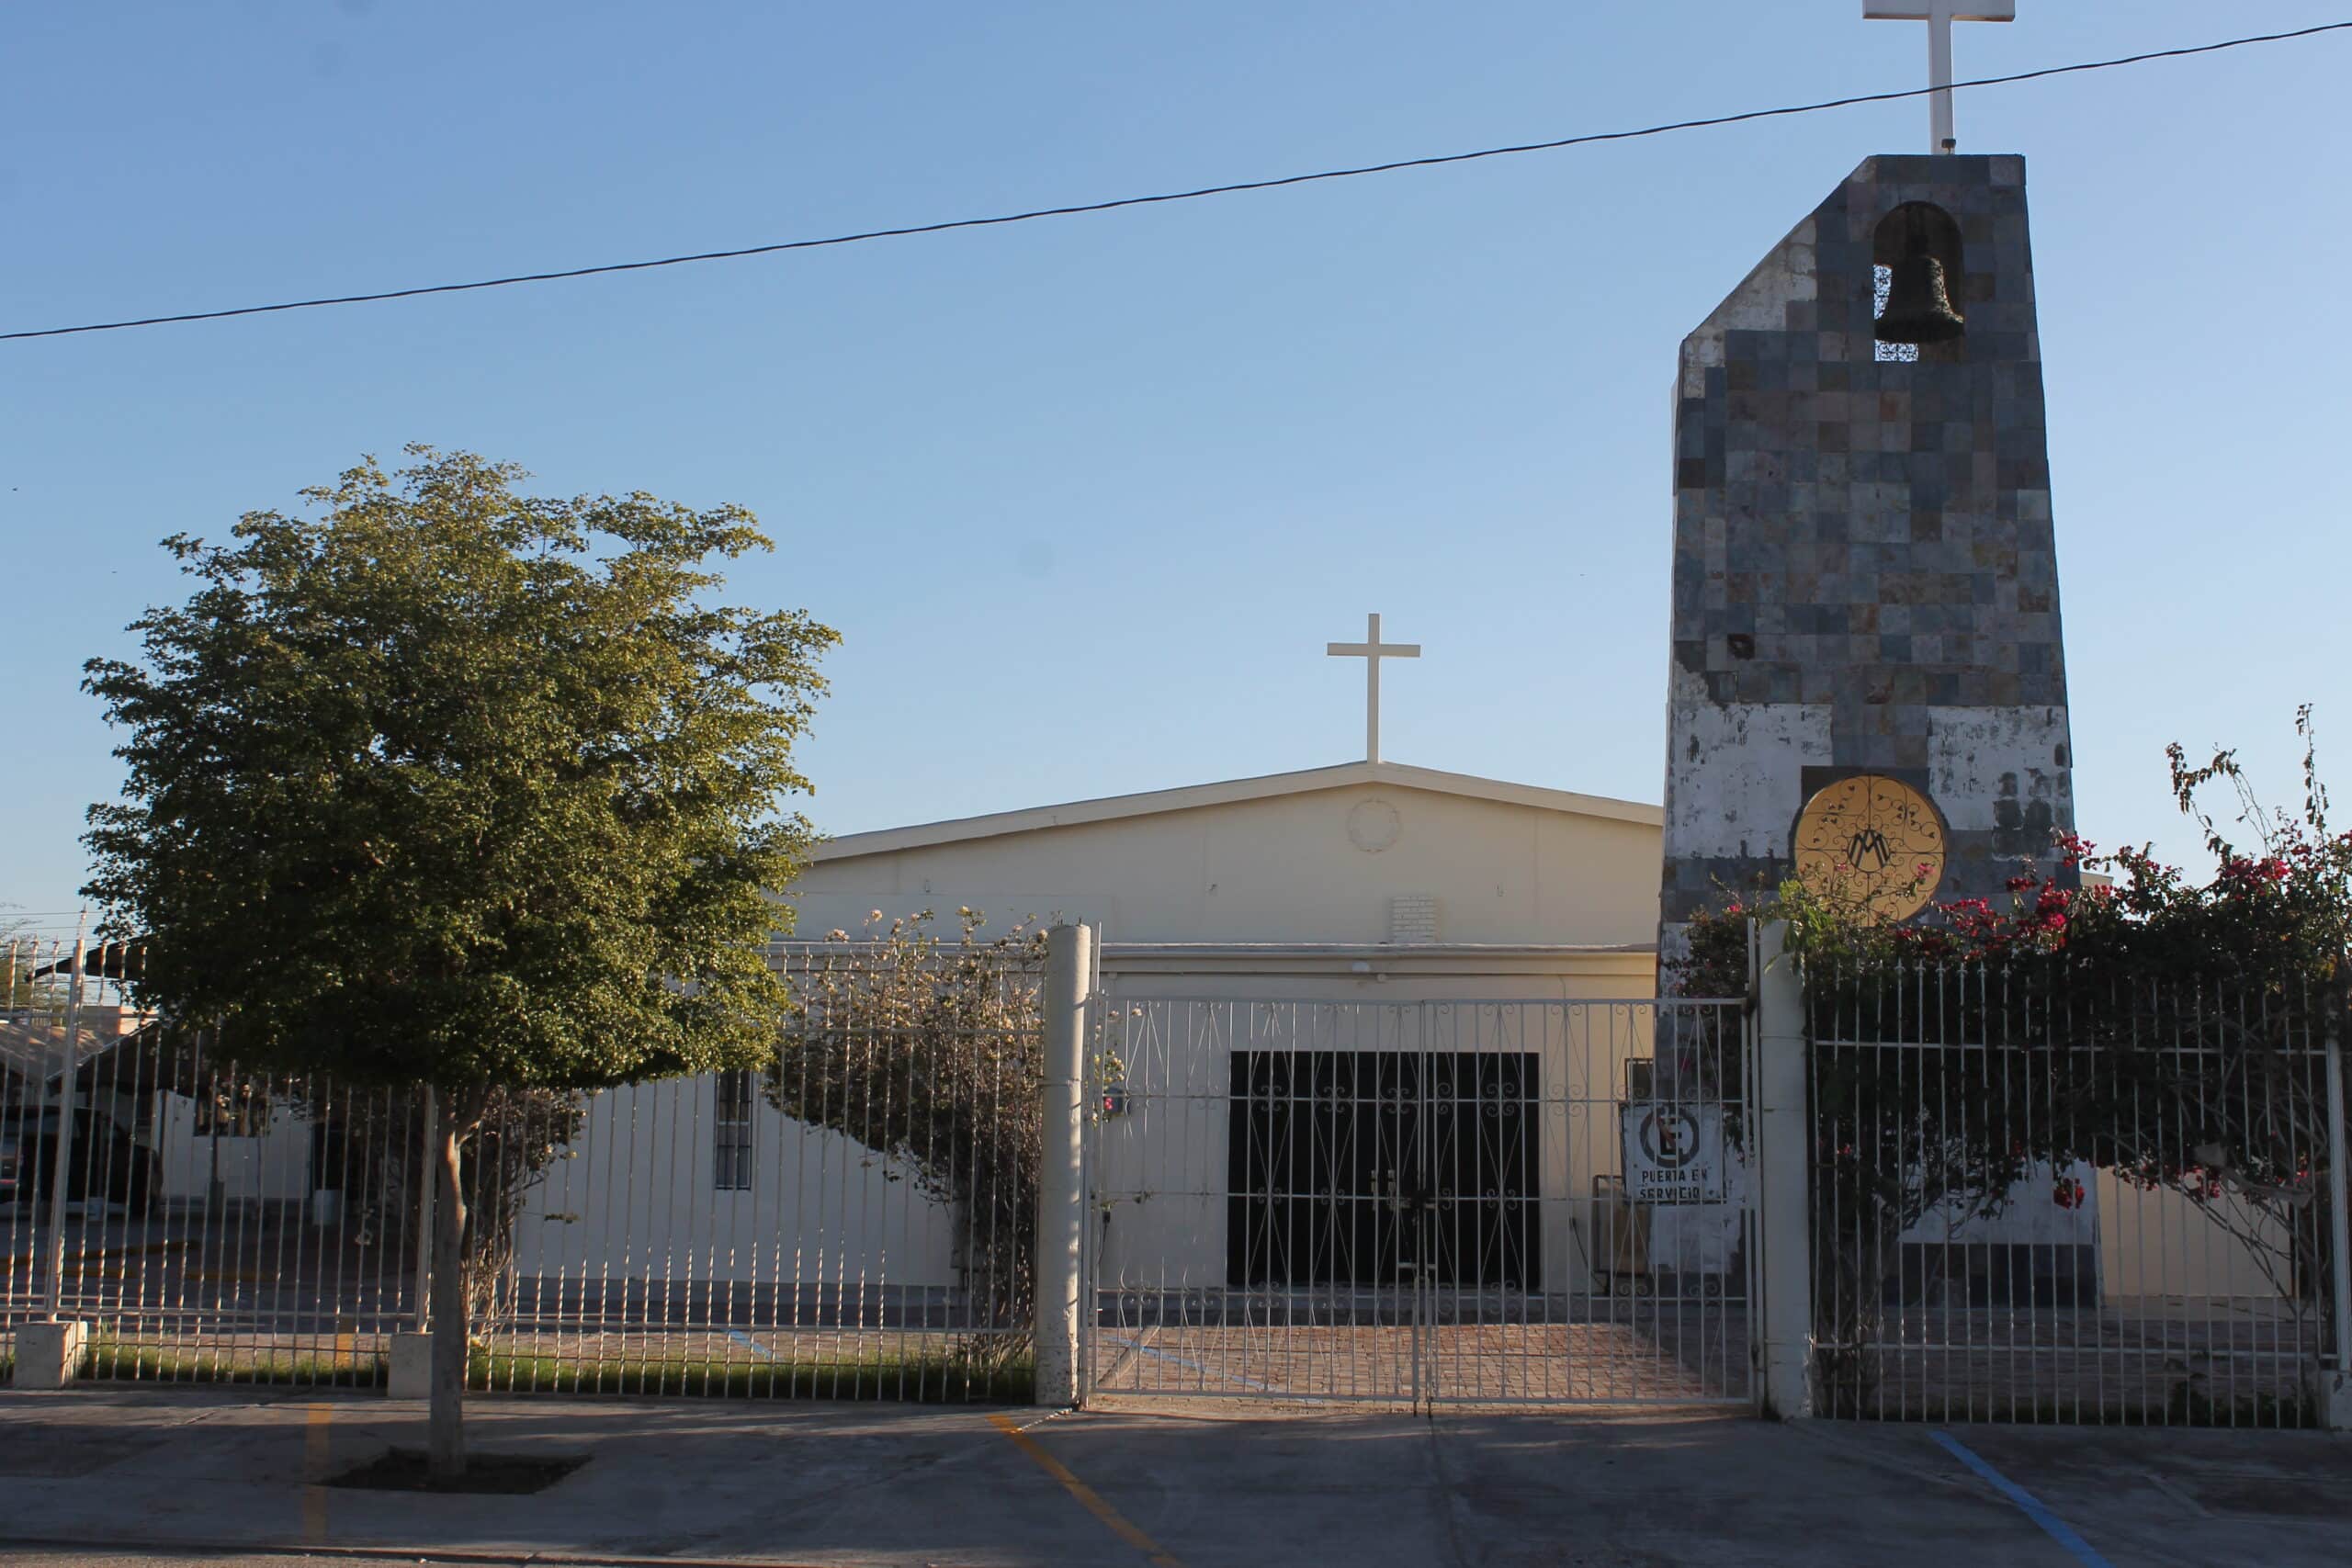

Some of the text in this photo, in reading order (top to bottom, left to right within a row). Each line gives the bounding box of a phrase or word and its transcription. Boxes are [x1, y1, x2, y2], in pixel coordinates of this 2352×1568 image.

[1660, 1118, 1682, 1156] E
[1642, 1168, 1707, 1182] PUERTA EN
[1640, 1187, 1700, 1199] SERVICIO
